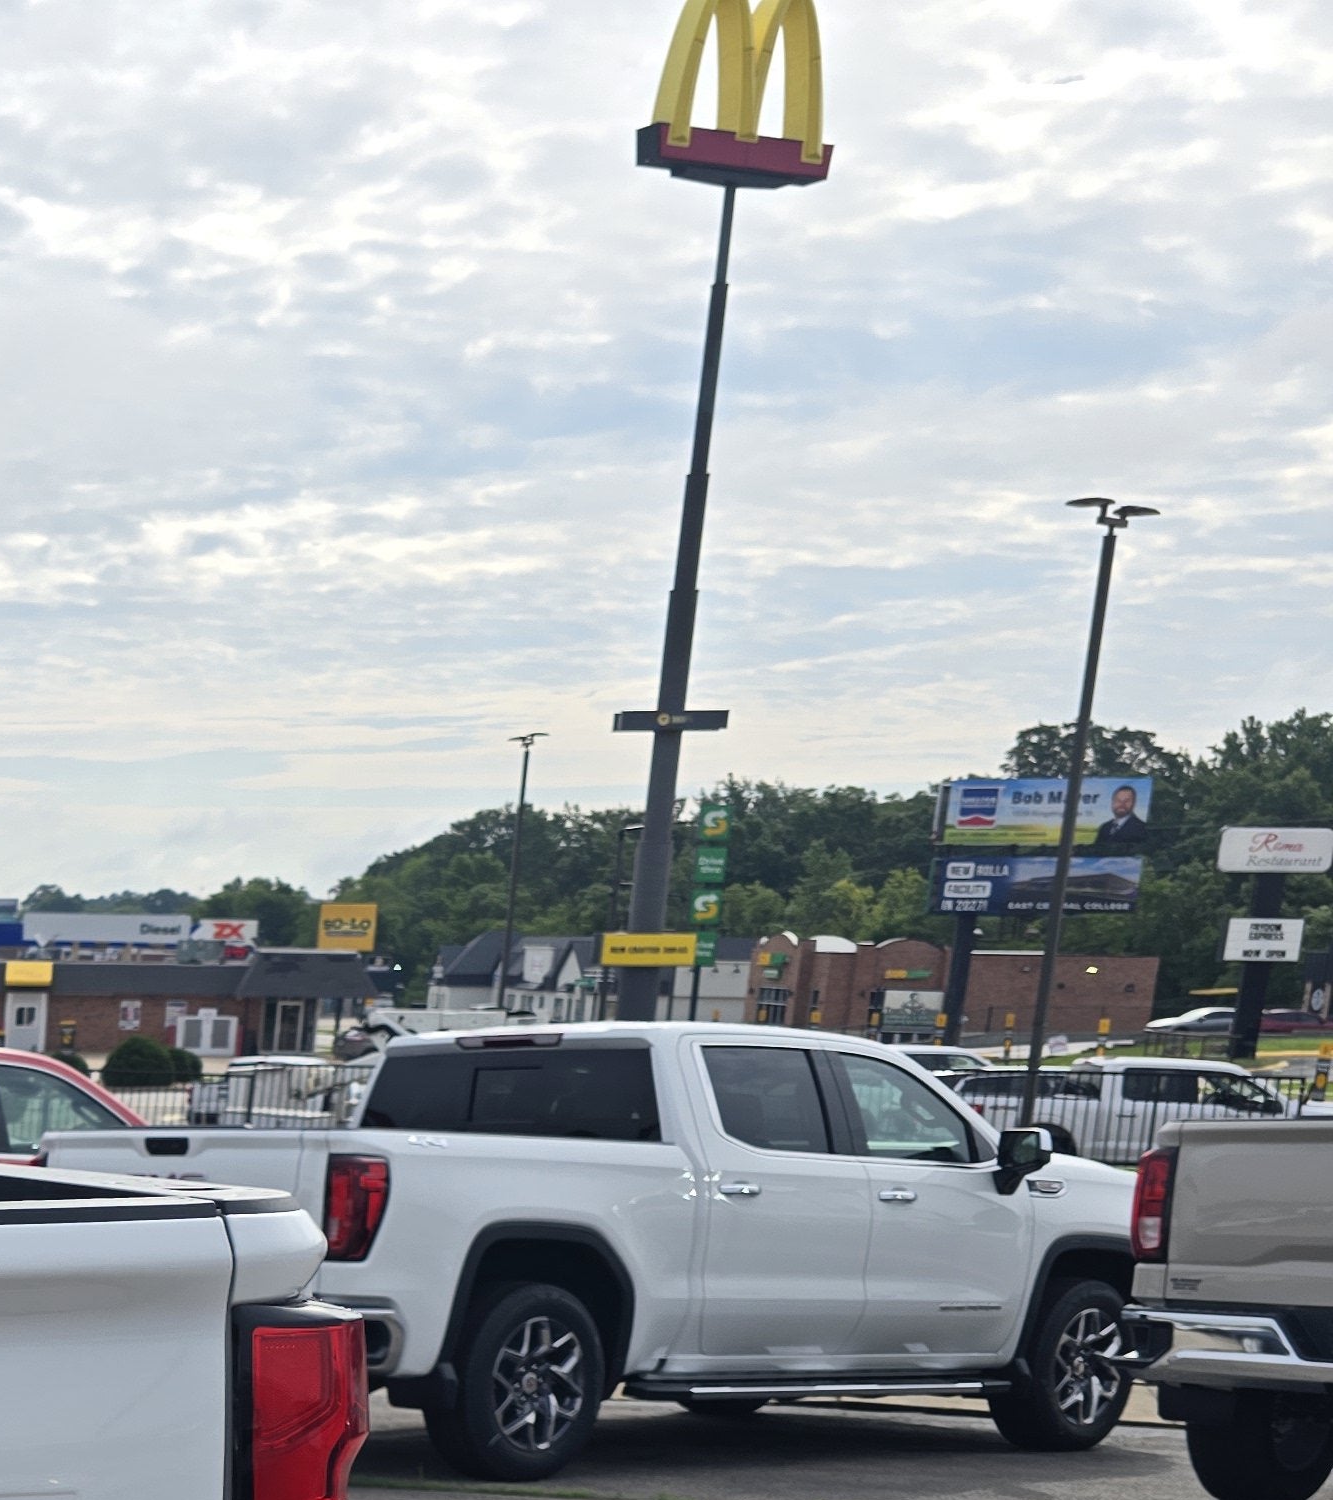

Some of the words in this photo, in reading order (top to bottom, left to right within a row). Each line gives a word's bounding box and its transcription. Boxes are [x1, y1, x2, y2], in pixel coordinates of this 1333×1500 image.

[1011, 791, 1043, 804] Bob
[1245, 854, 1323, 866] Restaurant
[139, 923, 181, 935] Diesel
[1265, 949, 1286, 958] OPEN
